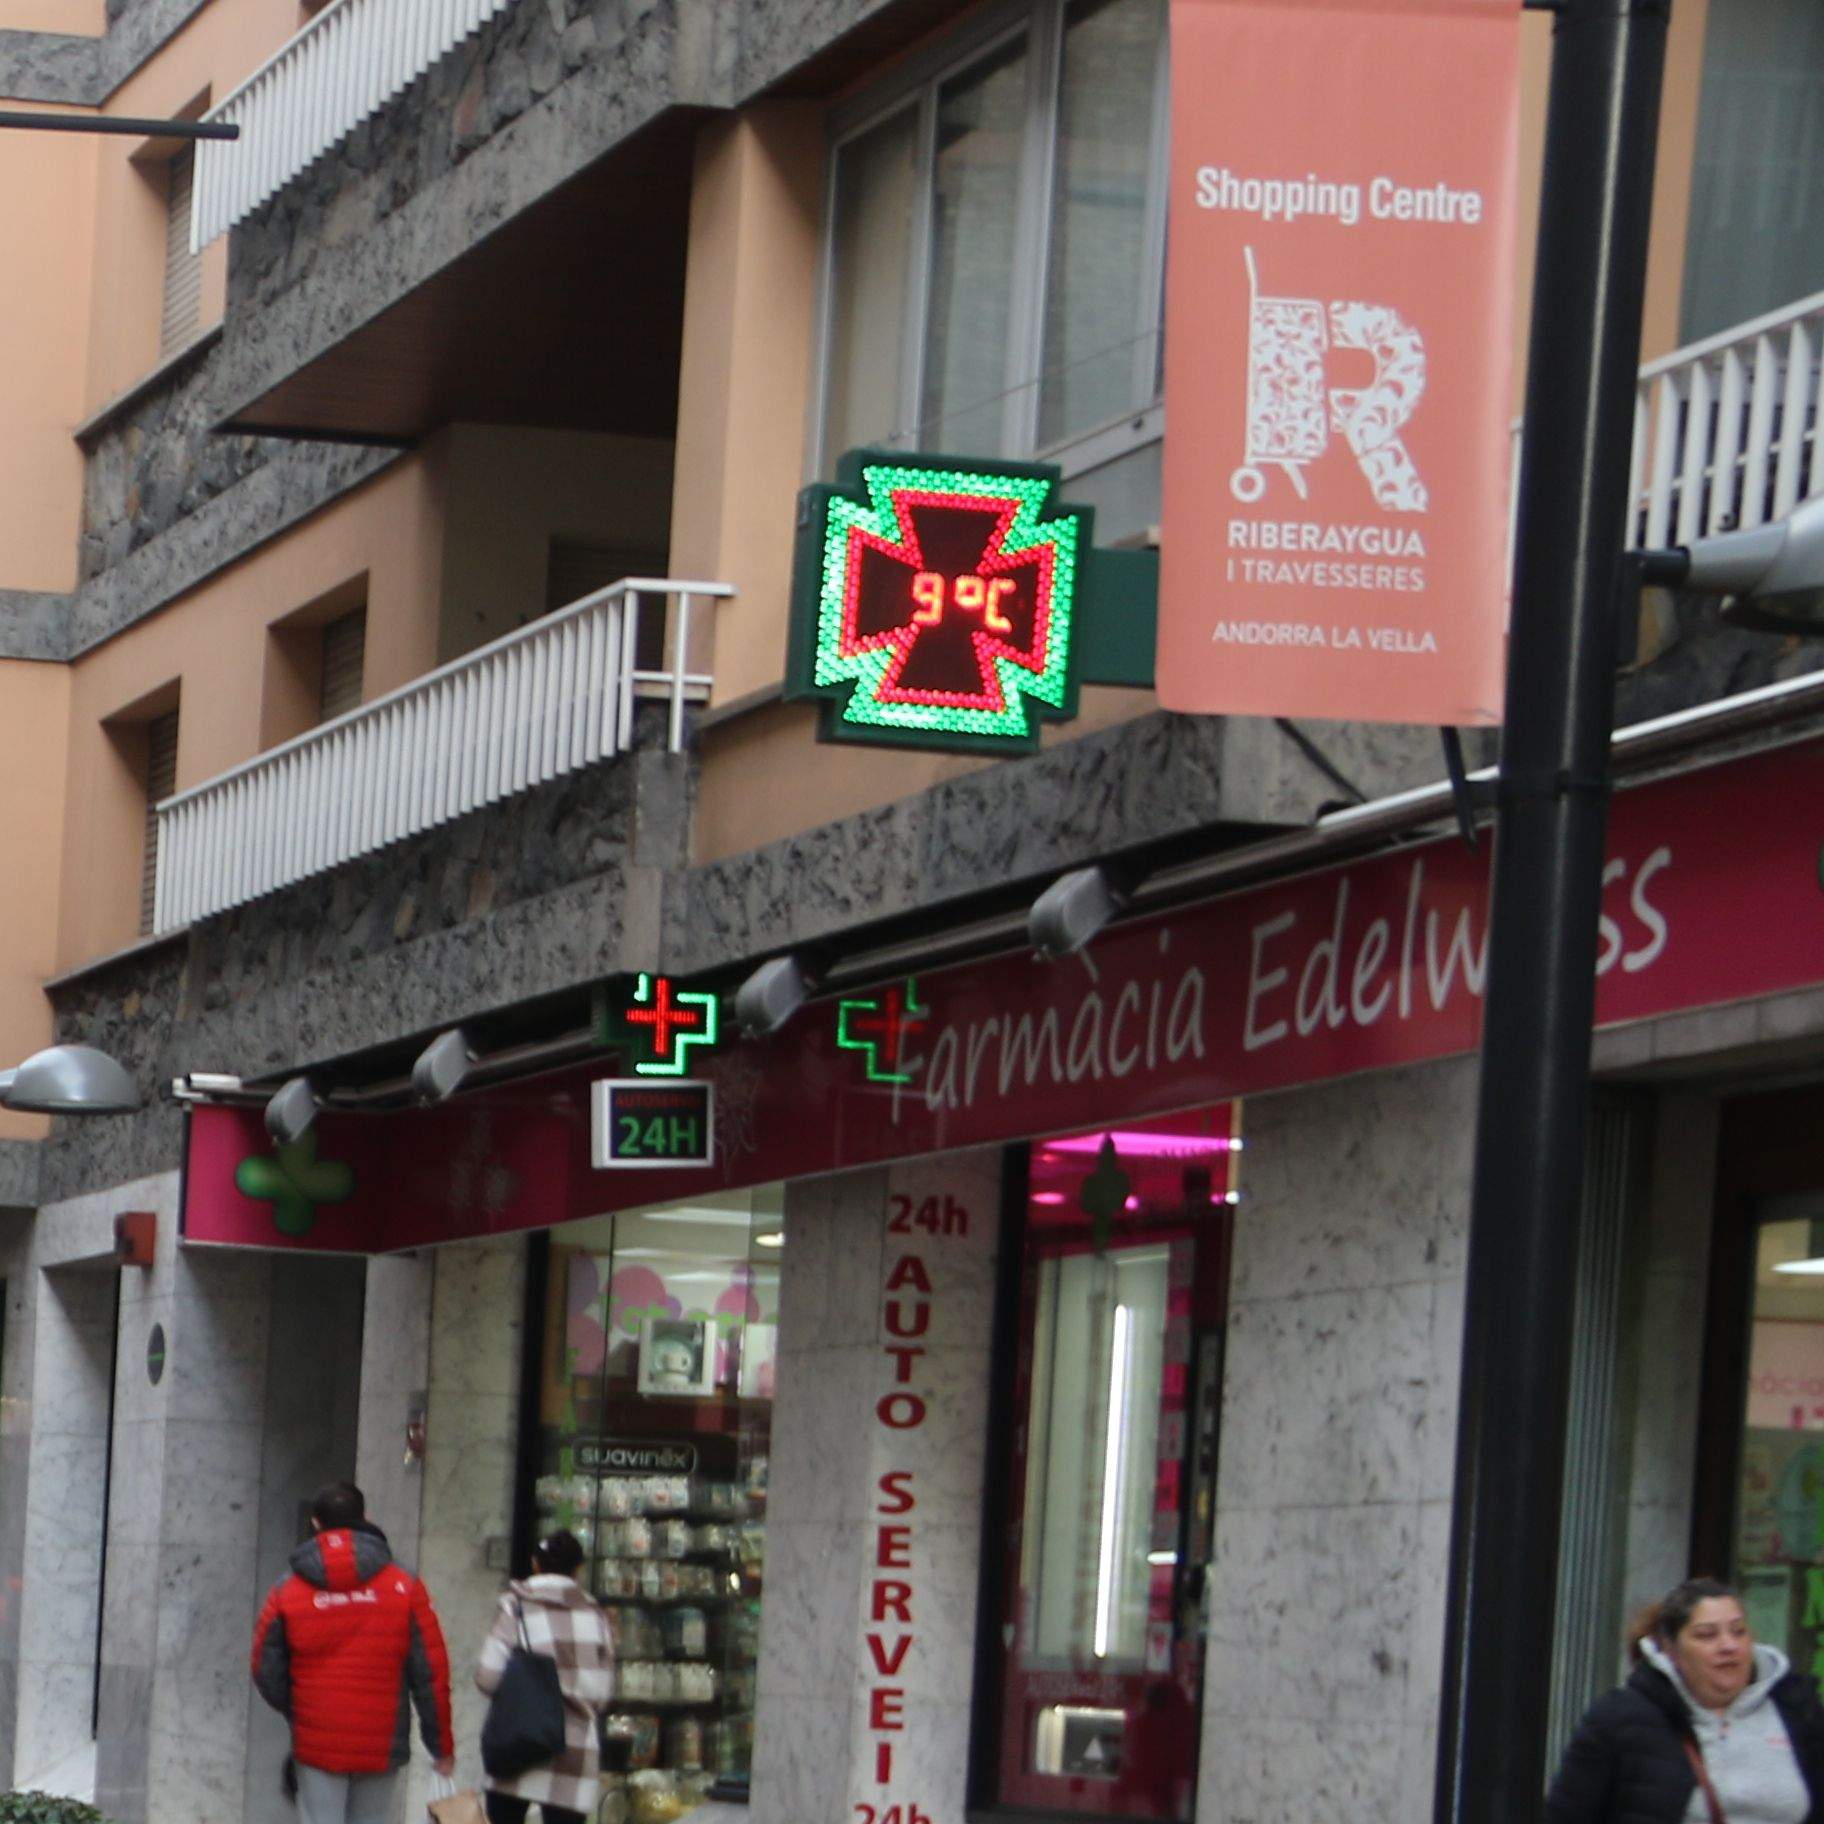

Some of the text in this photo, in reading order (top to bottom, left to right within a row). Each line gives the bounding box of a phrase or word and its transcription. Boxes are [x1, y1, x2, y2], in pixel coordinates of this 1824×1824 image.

[1195, 166, 1482, 226] Shopping Centre
[1227, 519, 1427, 558] RIBERAYGUA
[1226, 557, 1426, 592] I TRAVESSERES
[1212, 619, 1438, 653] ANDORRA LA VELLA
[617, 1115, 698, 1155] 24H
[888, 1193, 970, 1238] 24h
[865, 1255, 933, 1786] AUTO SERVEI
